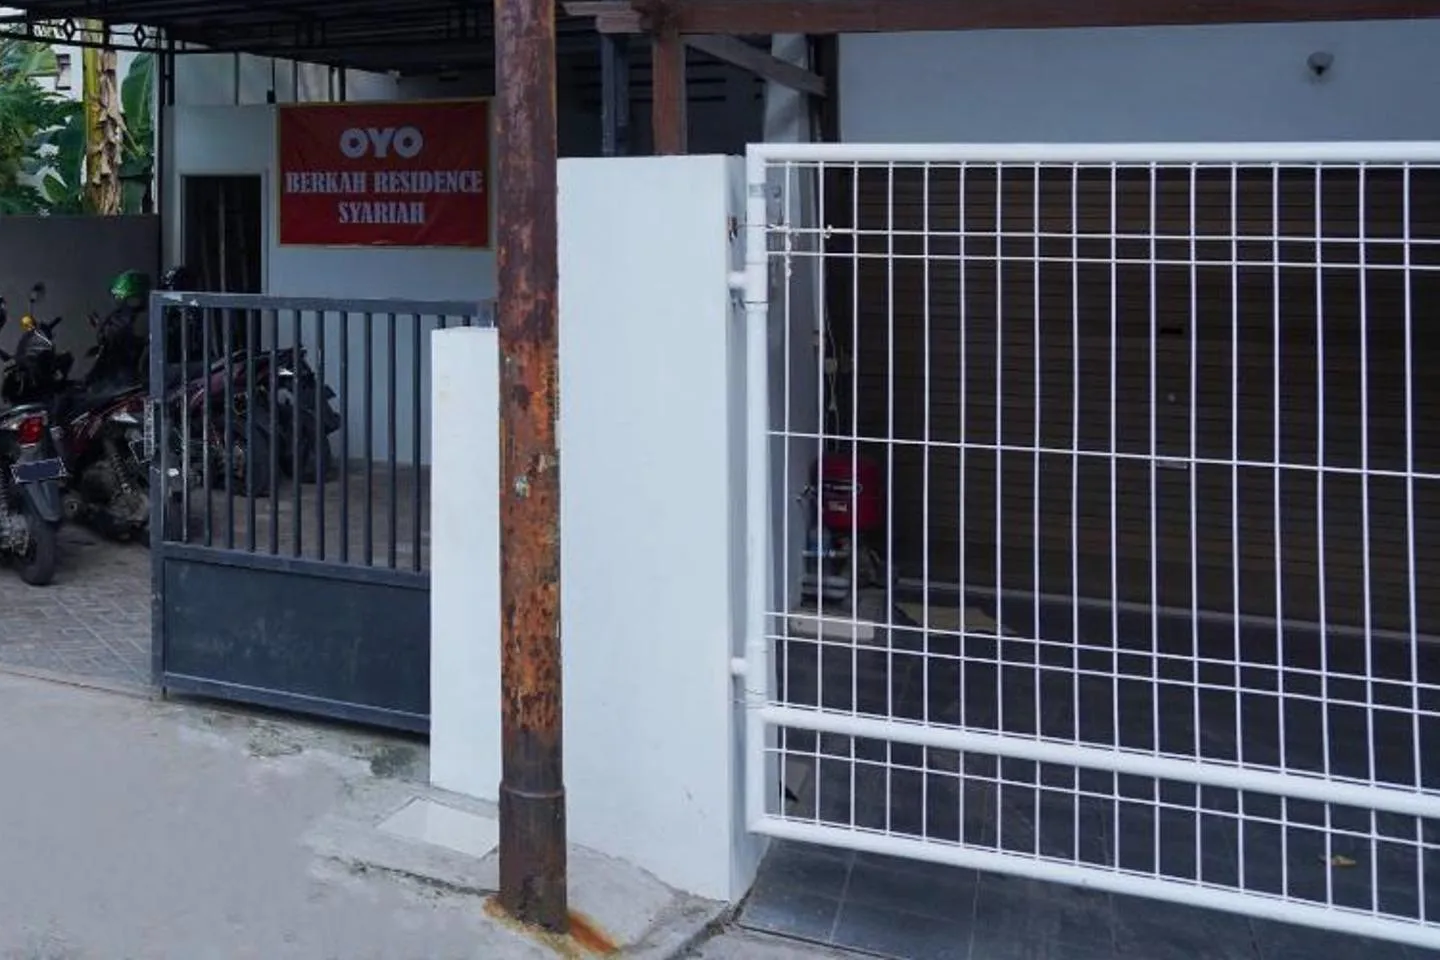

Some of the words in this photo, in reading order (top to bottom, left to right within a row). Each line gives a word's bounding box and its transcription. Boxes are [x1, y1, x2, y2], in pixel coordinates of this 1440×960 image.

[339, 126, 424, 159] OYO
[285, 171, 366, 193] BERKAH
[374, 170, 484, 193] RESIDENCE
[338, 201, 425, 224] SYARIAH
